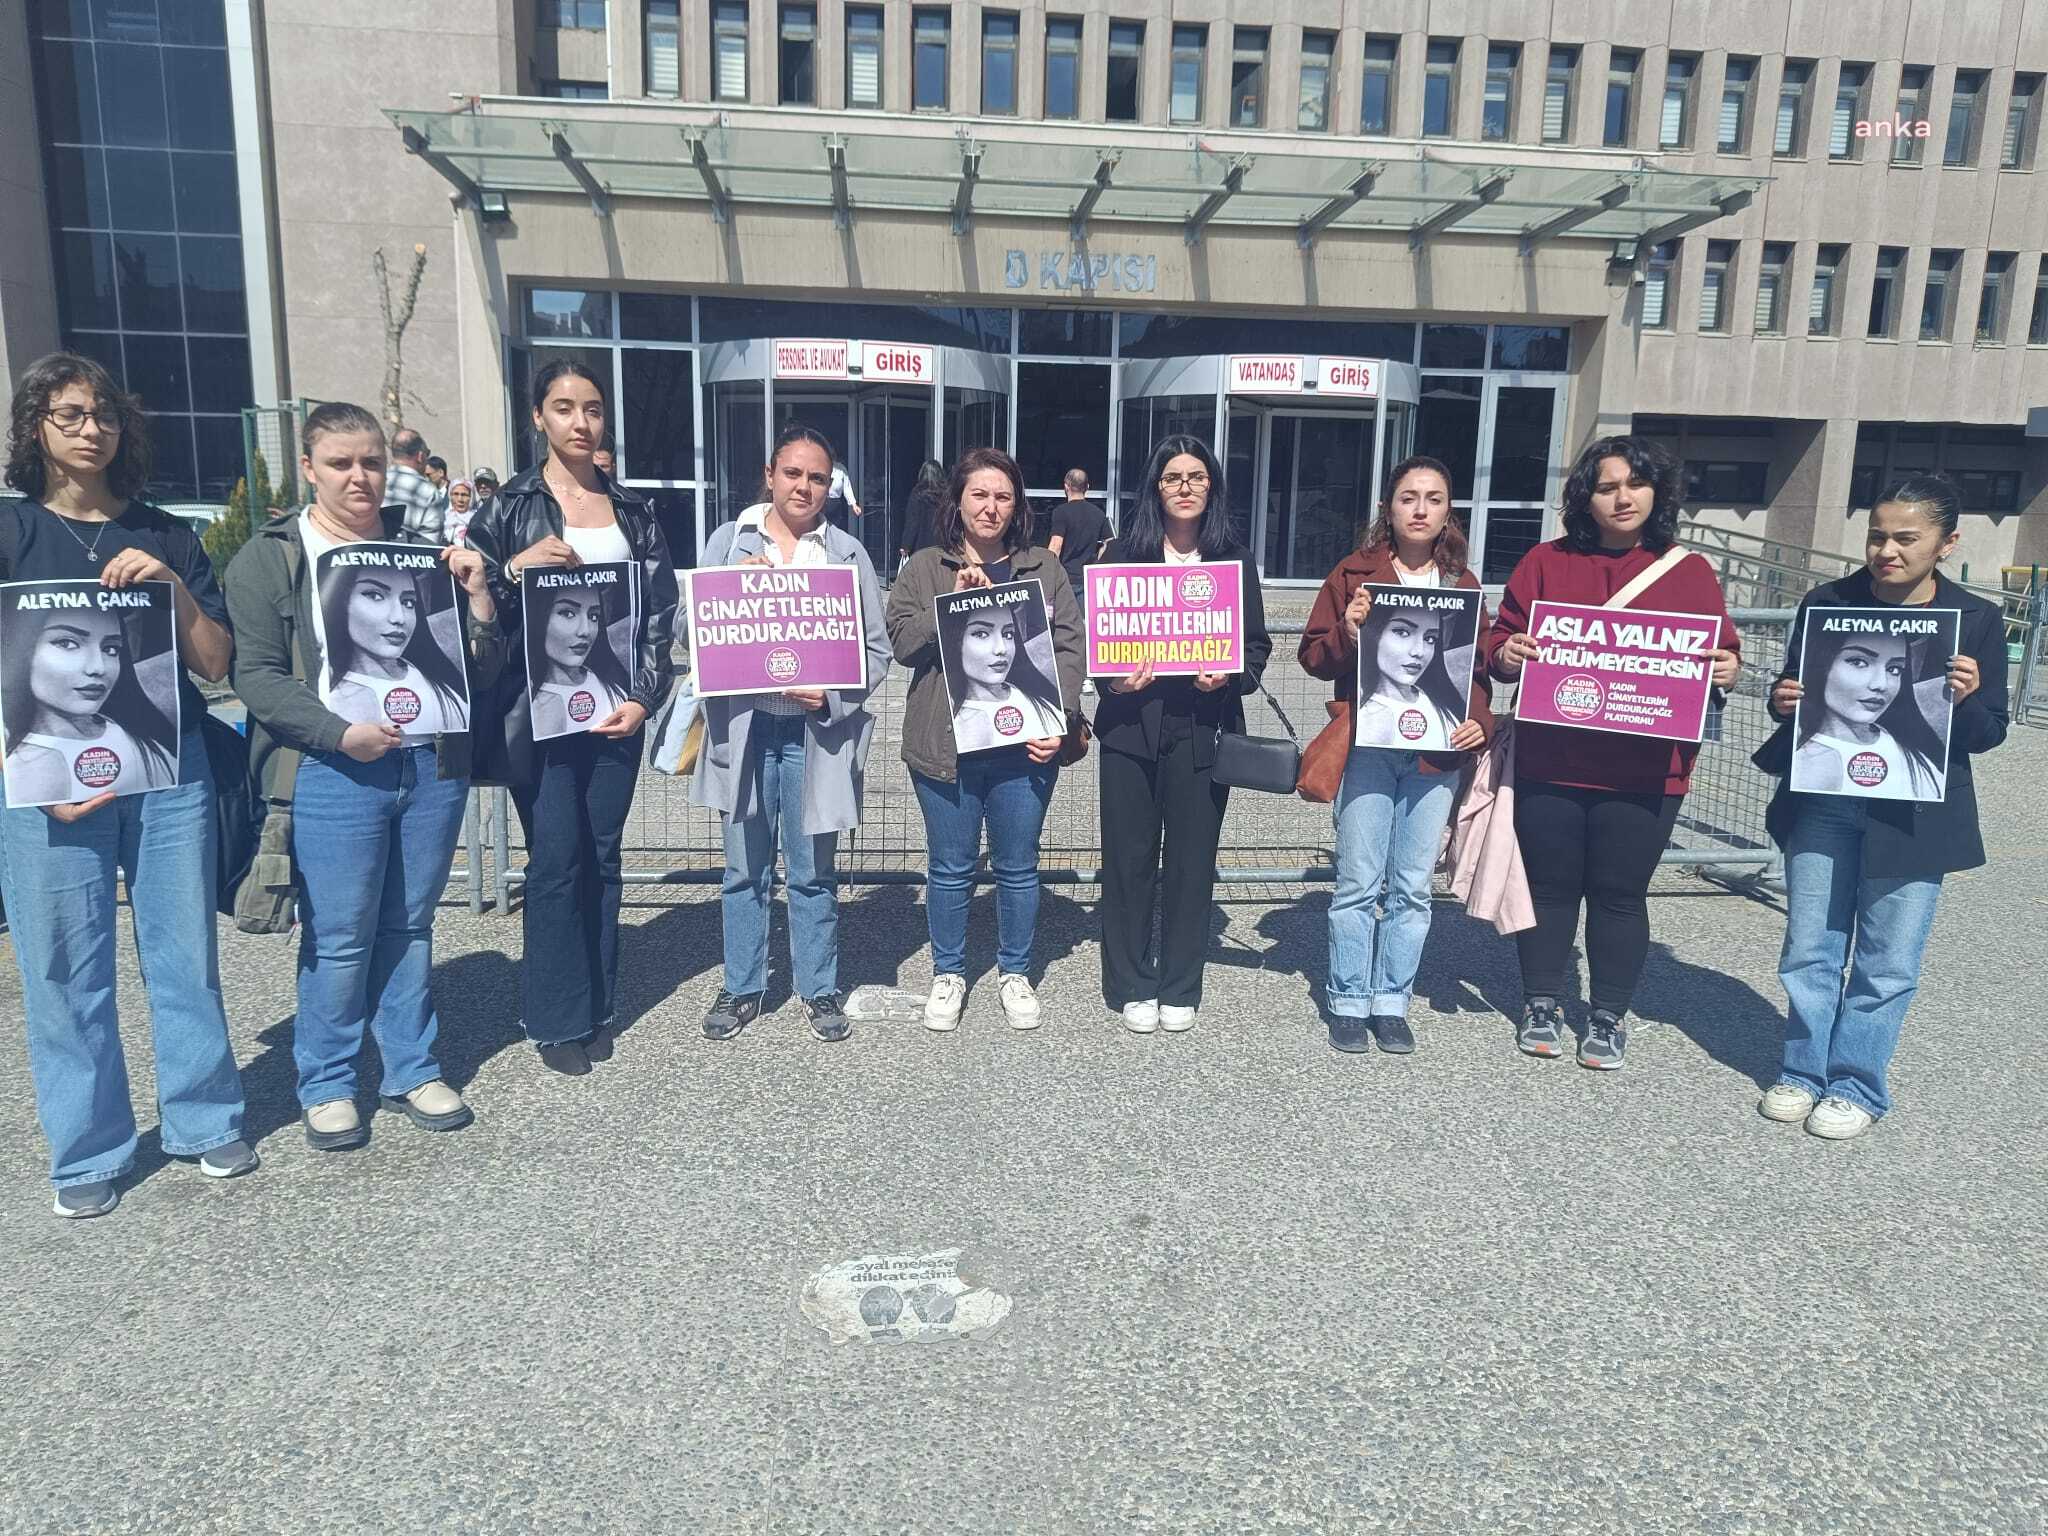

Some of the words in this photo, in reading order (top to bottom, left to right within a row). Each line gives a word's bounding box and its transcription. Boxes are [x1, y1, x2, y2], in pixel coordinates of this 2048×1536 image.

[1006, 250, 1028, 288] D
[1039, 252, 1156, 292] KAPISI
[778, 347, 809, 371] PERSONEL
[811, 347, 818, 371] VE
[820, 348, 845, 371] AVUKAT
[875, 349, 922, 377] GİRİŞ
[1239, 362, 1295, 386] VATANDAŞ
[1330, 364, 1370, 391] GİRİŞ
[330, 551, 391, 568] ALEYNA
[393, 553, 437, 570] ÇAKIR
[536, 573, 582, 588] ALEYNA
[584, 570, 617, 587] ÇAKIR
[740, 572, 810, 594] KADIN
[17, 592, 92, 610] ALEYNA
[96, 591, 151, 611] ÇAKIR
[949, 595, 993, 614] ALEYNA
[995, 589, 1030, 608] ÇAKIR
[1095, 575, 1174, 608] KADIN
[1374, 593, 1423, 608] ALEYNA
[1427, 596, 1465, 611] ÇAKIR
[698, 592, 853, 622] CİNAYETLERİNİ
[696, 618, 857, 648] DURDURACAĞIZ
[1096, 606, 1232, 636] CİNAYETLERİNİ
[1822, 618, 1884, 633] ALEYNA
[1889, 619, 1939, 636] ÇAKIR
[1536, 615, 1607, 645] ASLA
[1611, 623, 1709, 655] YALNIZ
[1097, 635, 1233, 664] DURDURACAĞIZ
[1535, 643, 1704, 681] YÜRÜMEYECEKSİN
[1608, 692, 1669, 706] CİNAYETLERİNİ
[1609, 682, 1637, 692] KADIN
[1604, 713, 1655, 726] PLATFORMU
[1606, 702, 1673, 718] DURDURACAĞIZ
[850, 1272, 907, 1282] dikkat
